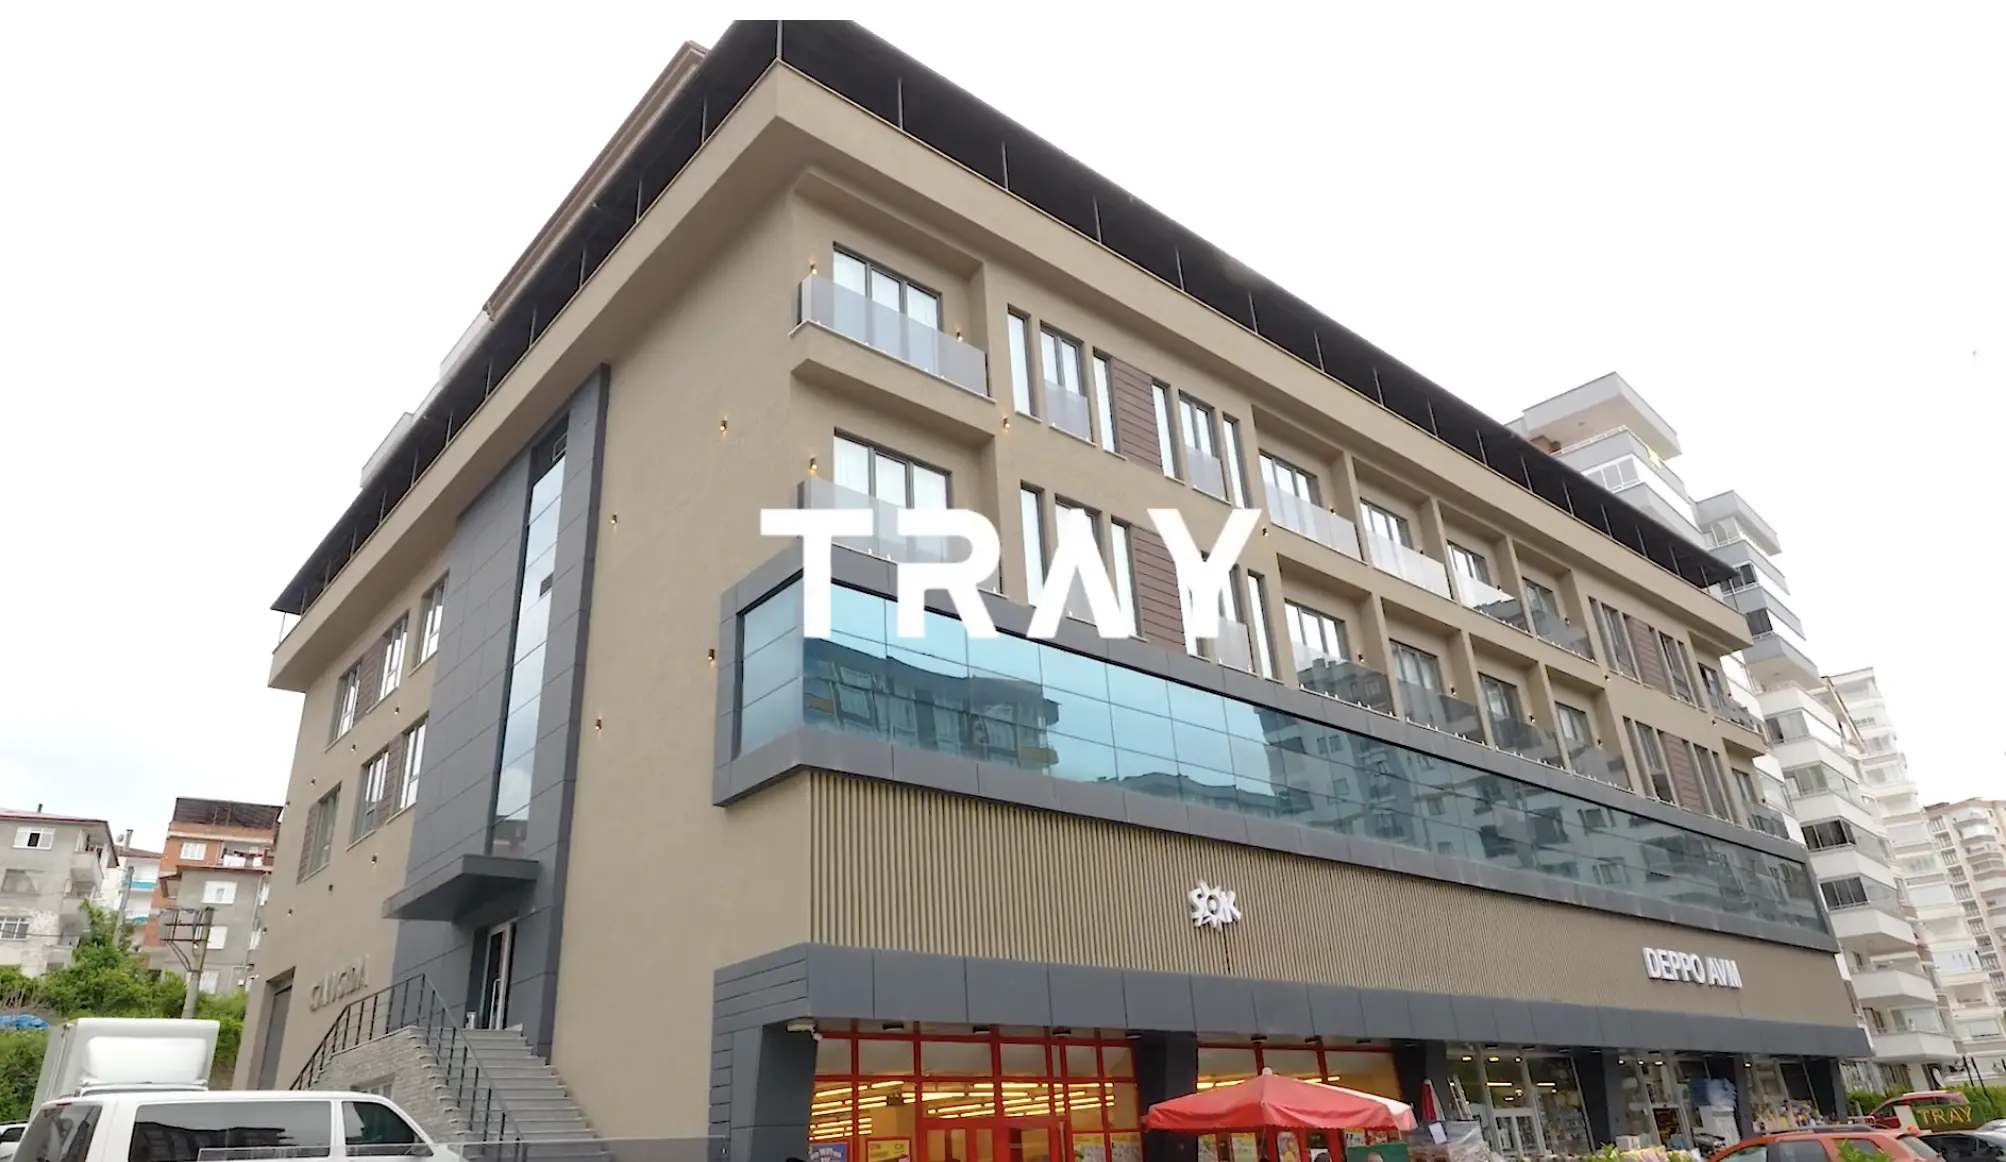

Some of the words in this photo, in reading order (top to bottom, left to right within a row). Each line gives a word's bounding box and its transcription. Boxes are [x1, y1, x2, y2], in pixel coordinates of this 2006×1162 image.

[1642, 947, 1706, 984] DEPPO
[1704, 956, 1743, 988] AVM
[1917, 1106, 1972, 1125] TRAY
